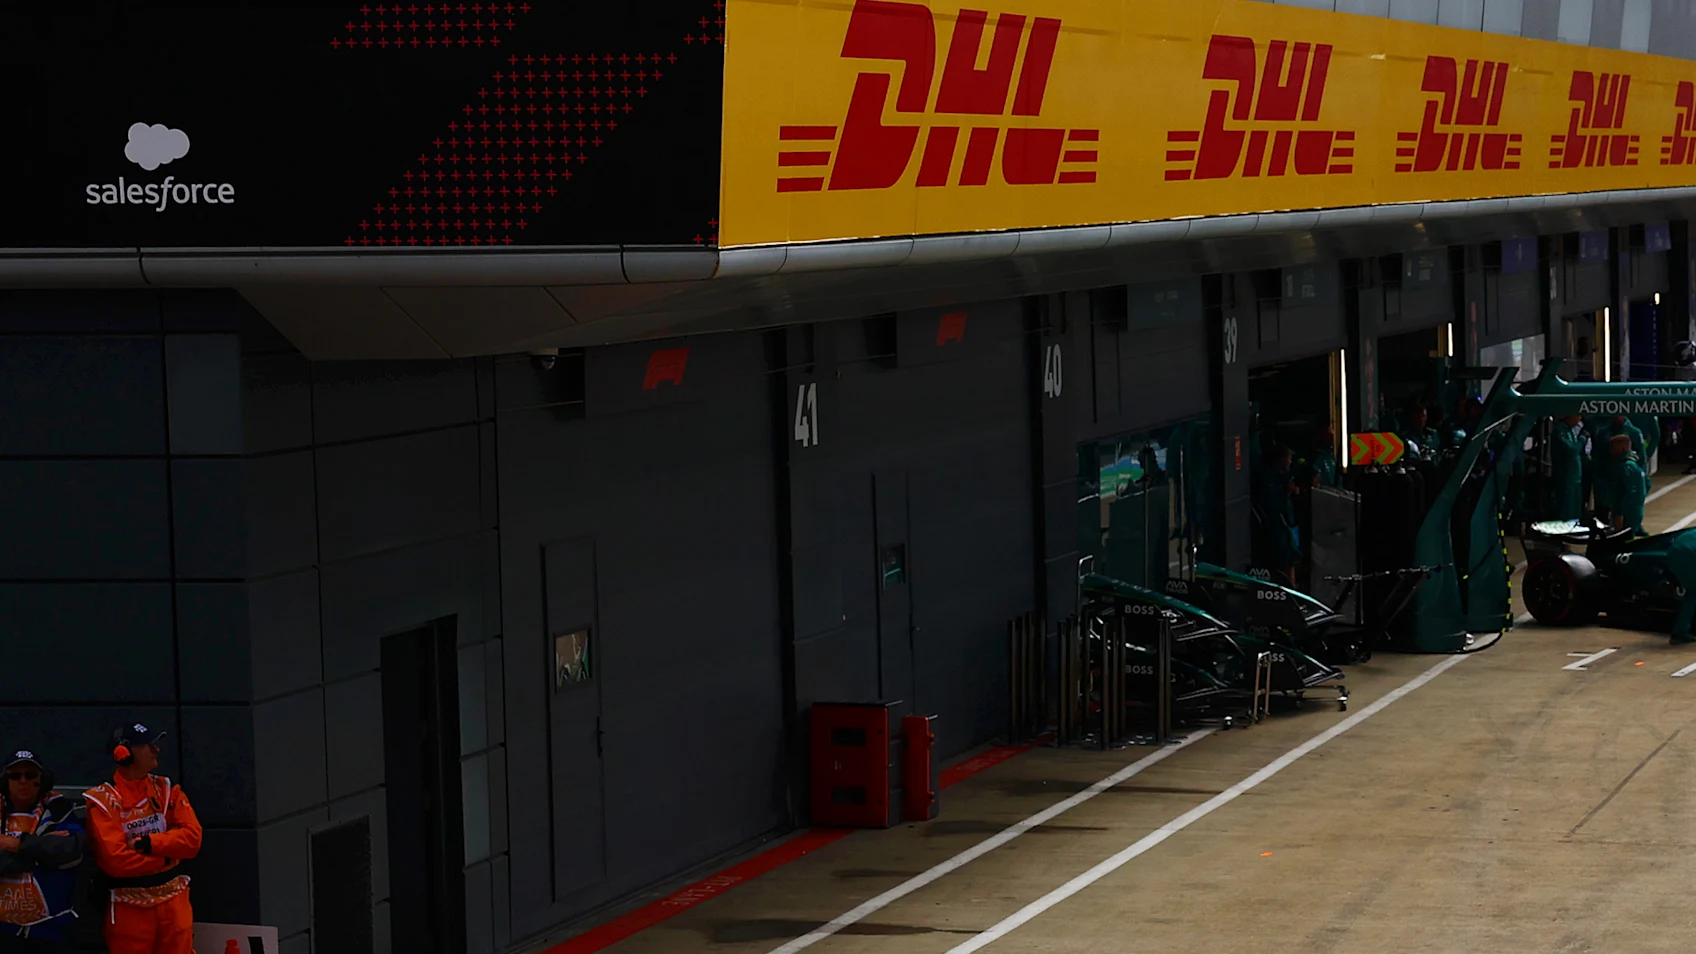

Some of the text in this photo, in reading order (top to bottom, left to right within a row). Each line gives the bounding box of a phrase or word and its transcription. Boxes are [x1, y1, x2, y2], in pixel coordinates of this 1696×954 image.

[828, 0, 1065, 190] DHL
[1194, 34, 1334, 180] DHL
[1414, 55, 1509, 171] DHL
[1563, 71, 1631, 168] DHL
[85, 176, 235, 212] salesforce
[1223, 316, 1238, 364] 39
[1044, 344, 1062, 398] 40
[794, 382, 819, 447] 41
[1579, 401, 1632, 414] ASTON
[1635, 400, 1695, 414] MARTIN
[1166, 580, 1188, 590] AVA
[1257, 590, 1287, 601] BOSS
[1124, 604, 1155, 616] BOSS
[1125, 664, 1154, 675] BOSS
